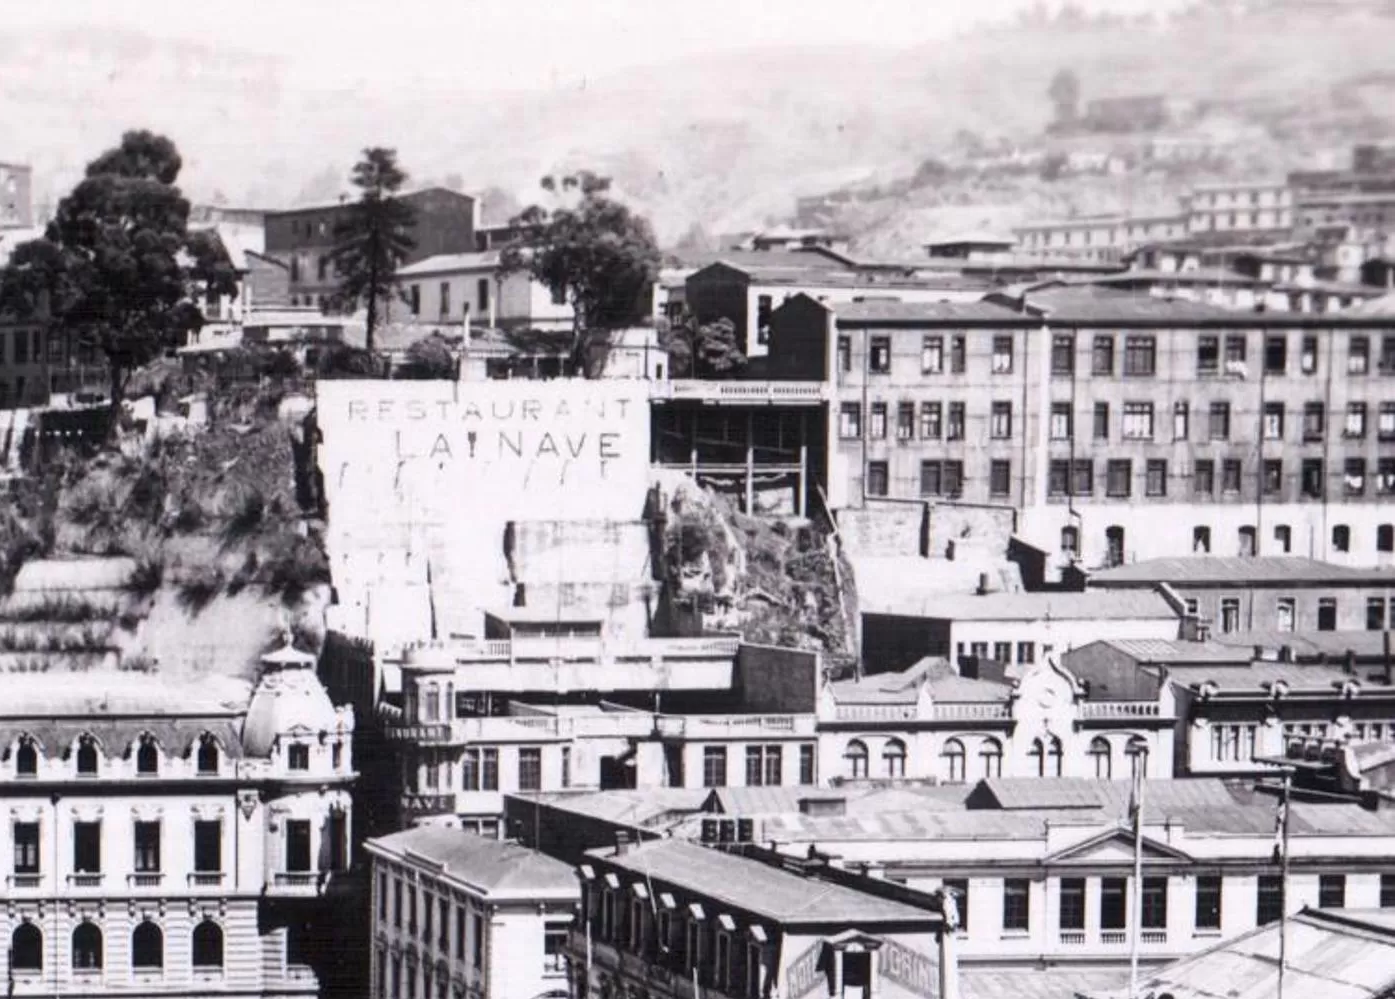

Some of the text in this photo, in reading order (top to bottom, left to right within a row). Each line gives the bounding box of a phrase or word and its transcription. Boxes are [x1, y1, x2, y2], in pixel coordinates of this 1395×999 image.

[395, 430, 621, 459] LA NAVE
[400, 796, 447, 810] NAVE
